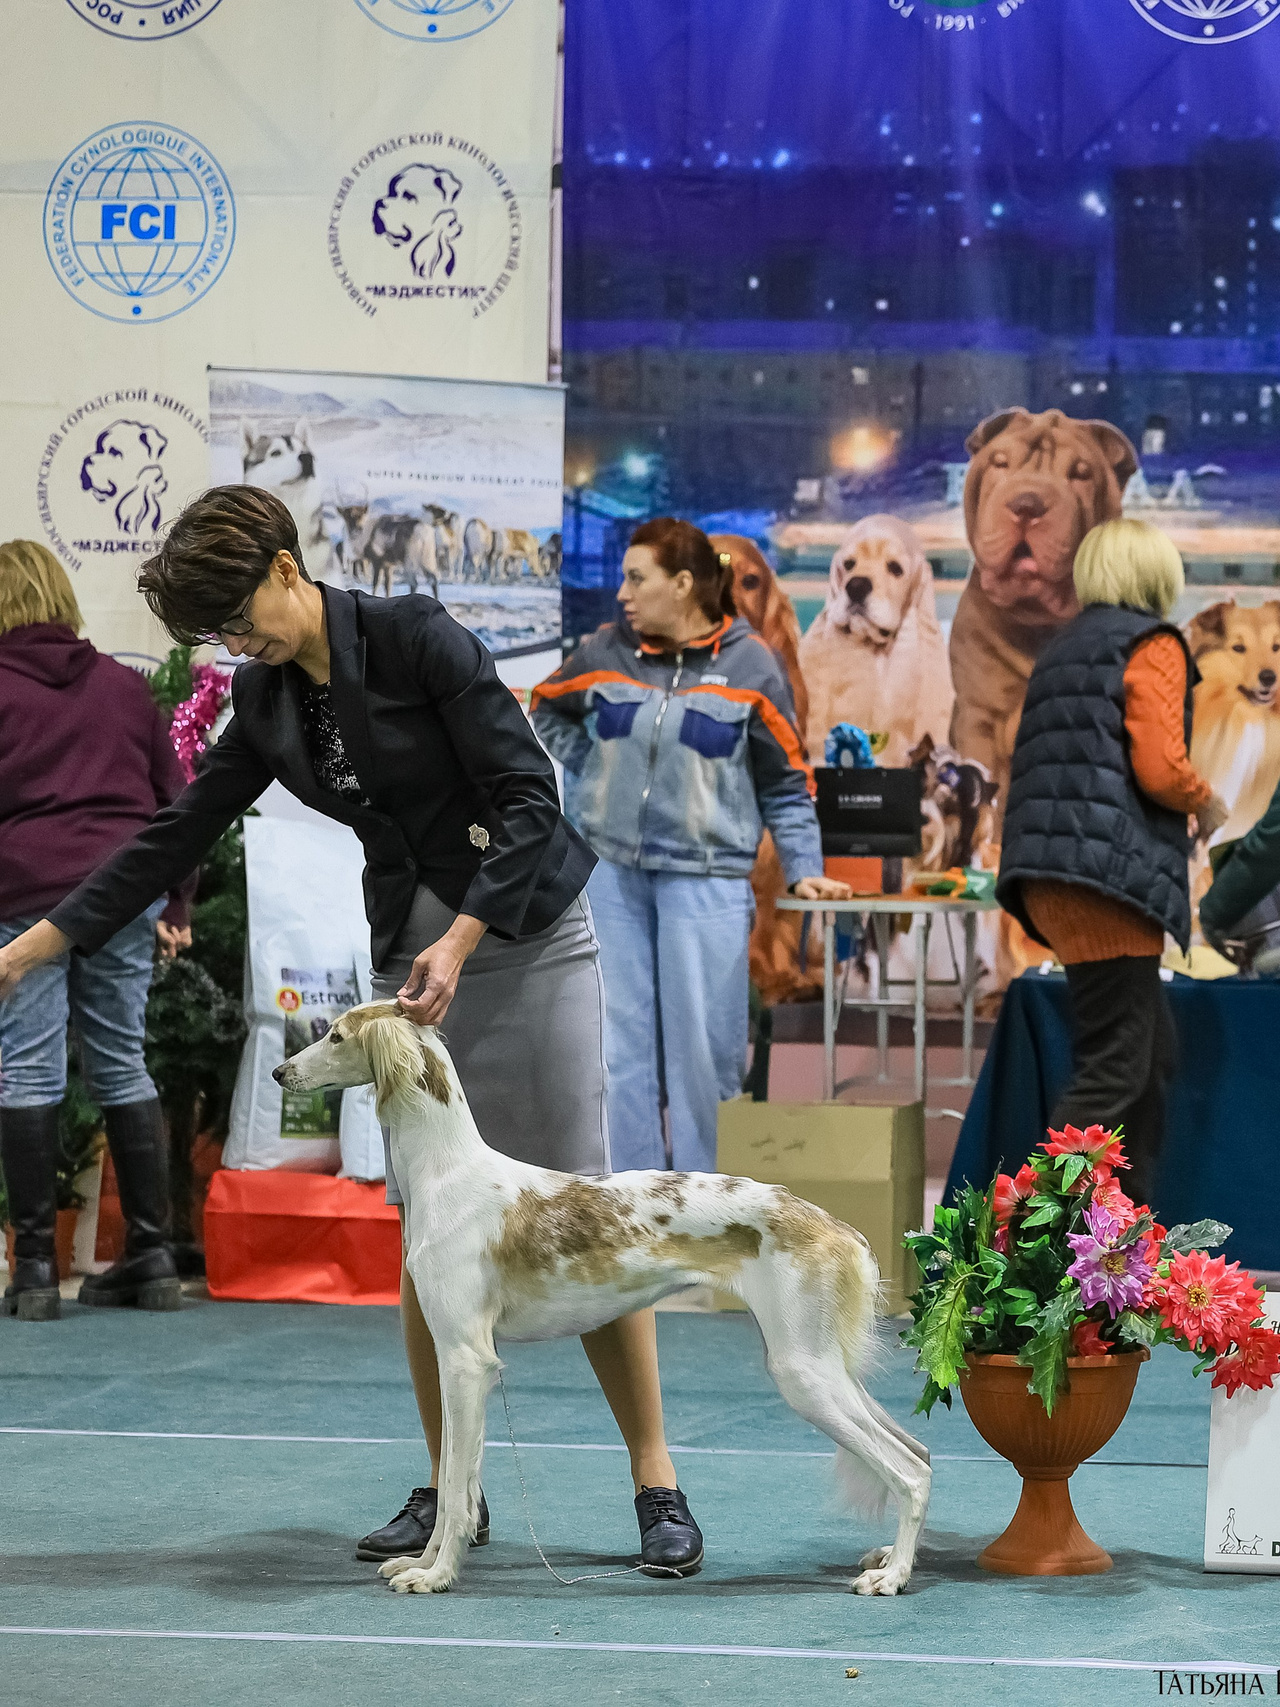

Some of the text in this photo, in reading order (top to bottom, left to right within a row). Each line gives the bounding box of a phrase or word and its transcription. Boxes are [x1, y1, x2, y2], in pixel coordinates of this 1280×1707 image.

[935, 13, 975, 32] 1991
[352, 131, 444, 177] ГОРОДСКОЙ
[52, 128, 228, 296] FEDERATION CYNOLOGIQUE INTERNATIONALE
[101, 203, 176, 240] FCI
[60, 387, 148, 435] ГОРОДСКОЙ
[72, 540, 165, 554] “МЭДЖЕСТ
